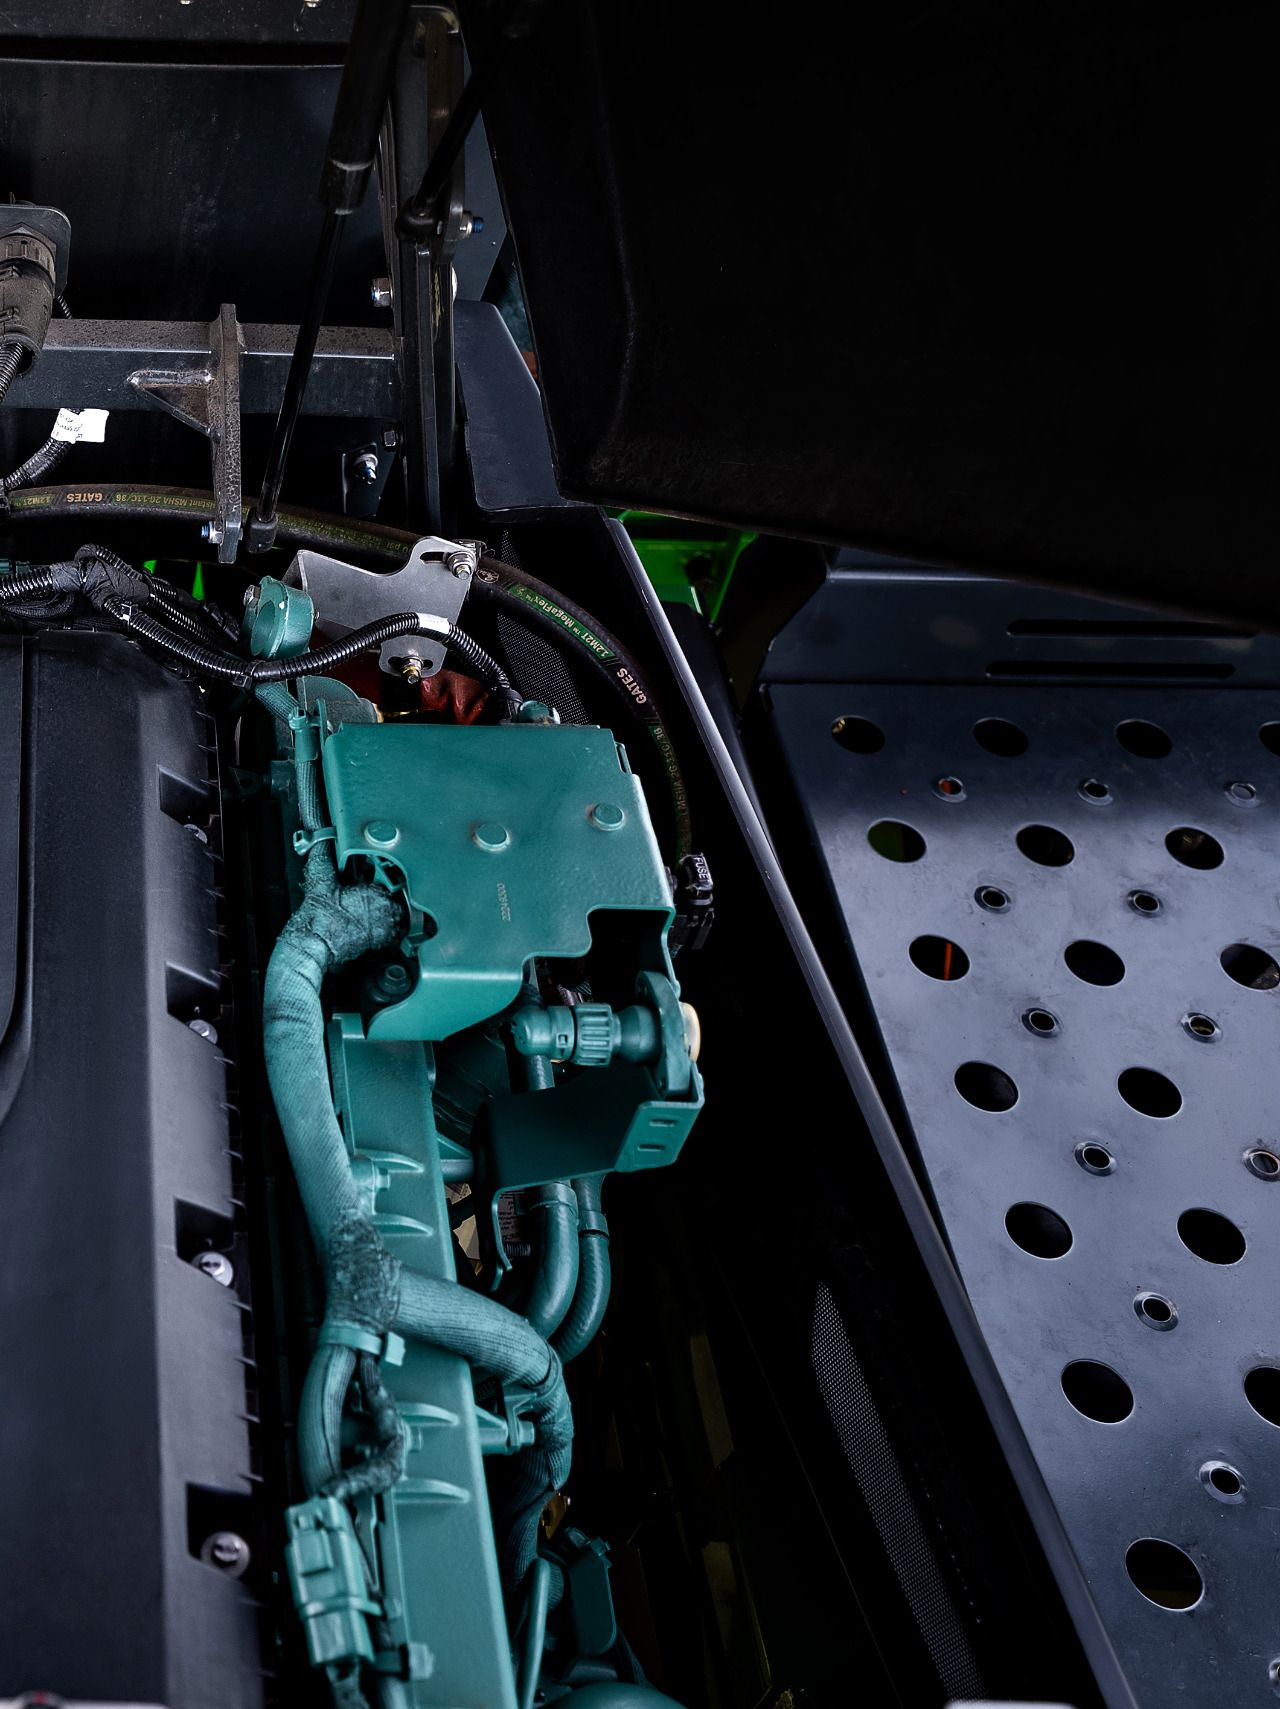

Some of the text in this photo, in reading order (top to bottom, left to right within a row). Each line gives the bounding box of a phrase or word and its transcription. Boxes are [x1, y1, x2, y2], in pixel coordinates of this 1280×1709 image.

[66, 492, 103, 503] GATES
[616, 667, 647, 705] GATES
[692, 856, 710, 881] FUSE
